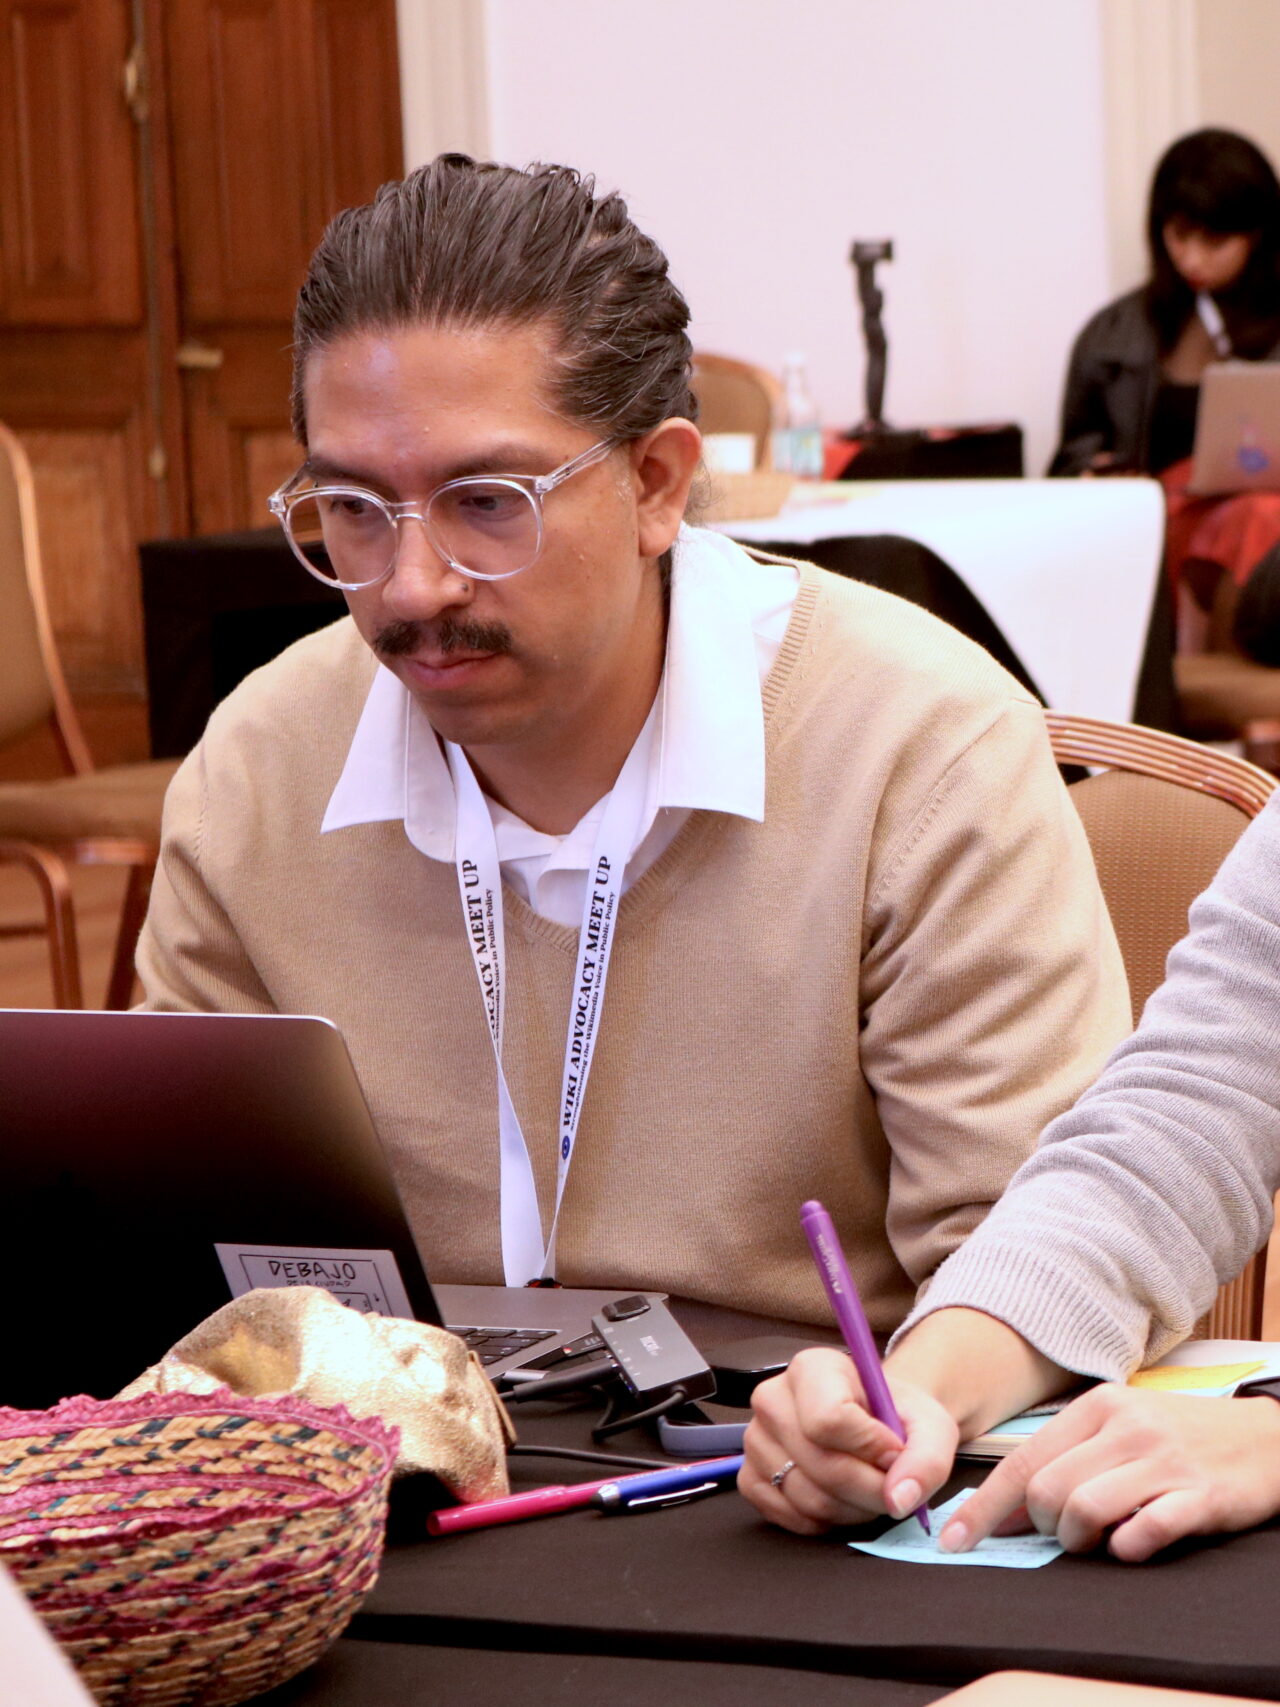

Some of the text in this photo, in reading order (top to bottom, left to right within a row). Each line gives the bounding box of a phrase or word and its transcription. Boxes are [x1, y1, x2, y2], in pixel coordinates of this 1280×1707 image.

[462, 860, 479, 888] UP
[485, 889, 494, 917] Policy
[605, 891, 616, 920] Policy
[467, 895, 487, 954] MEET
[487, 919, 496, 949] Public
[600, 923, 610, 951] Public
[492, 951, 498, 960] in
[599, 954, 605, 963] in
[594, 965, 603, 988] Voice
[563, 856, 611, 1126] WIKI ADVOCACY MEET UP
[586, 991, 599, 1040] Wikimedia
[268, 1260, 356, 1280] DEBAJO
